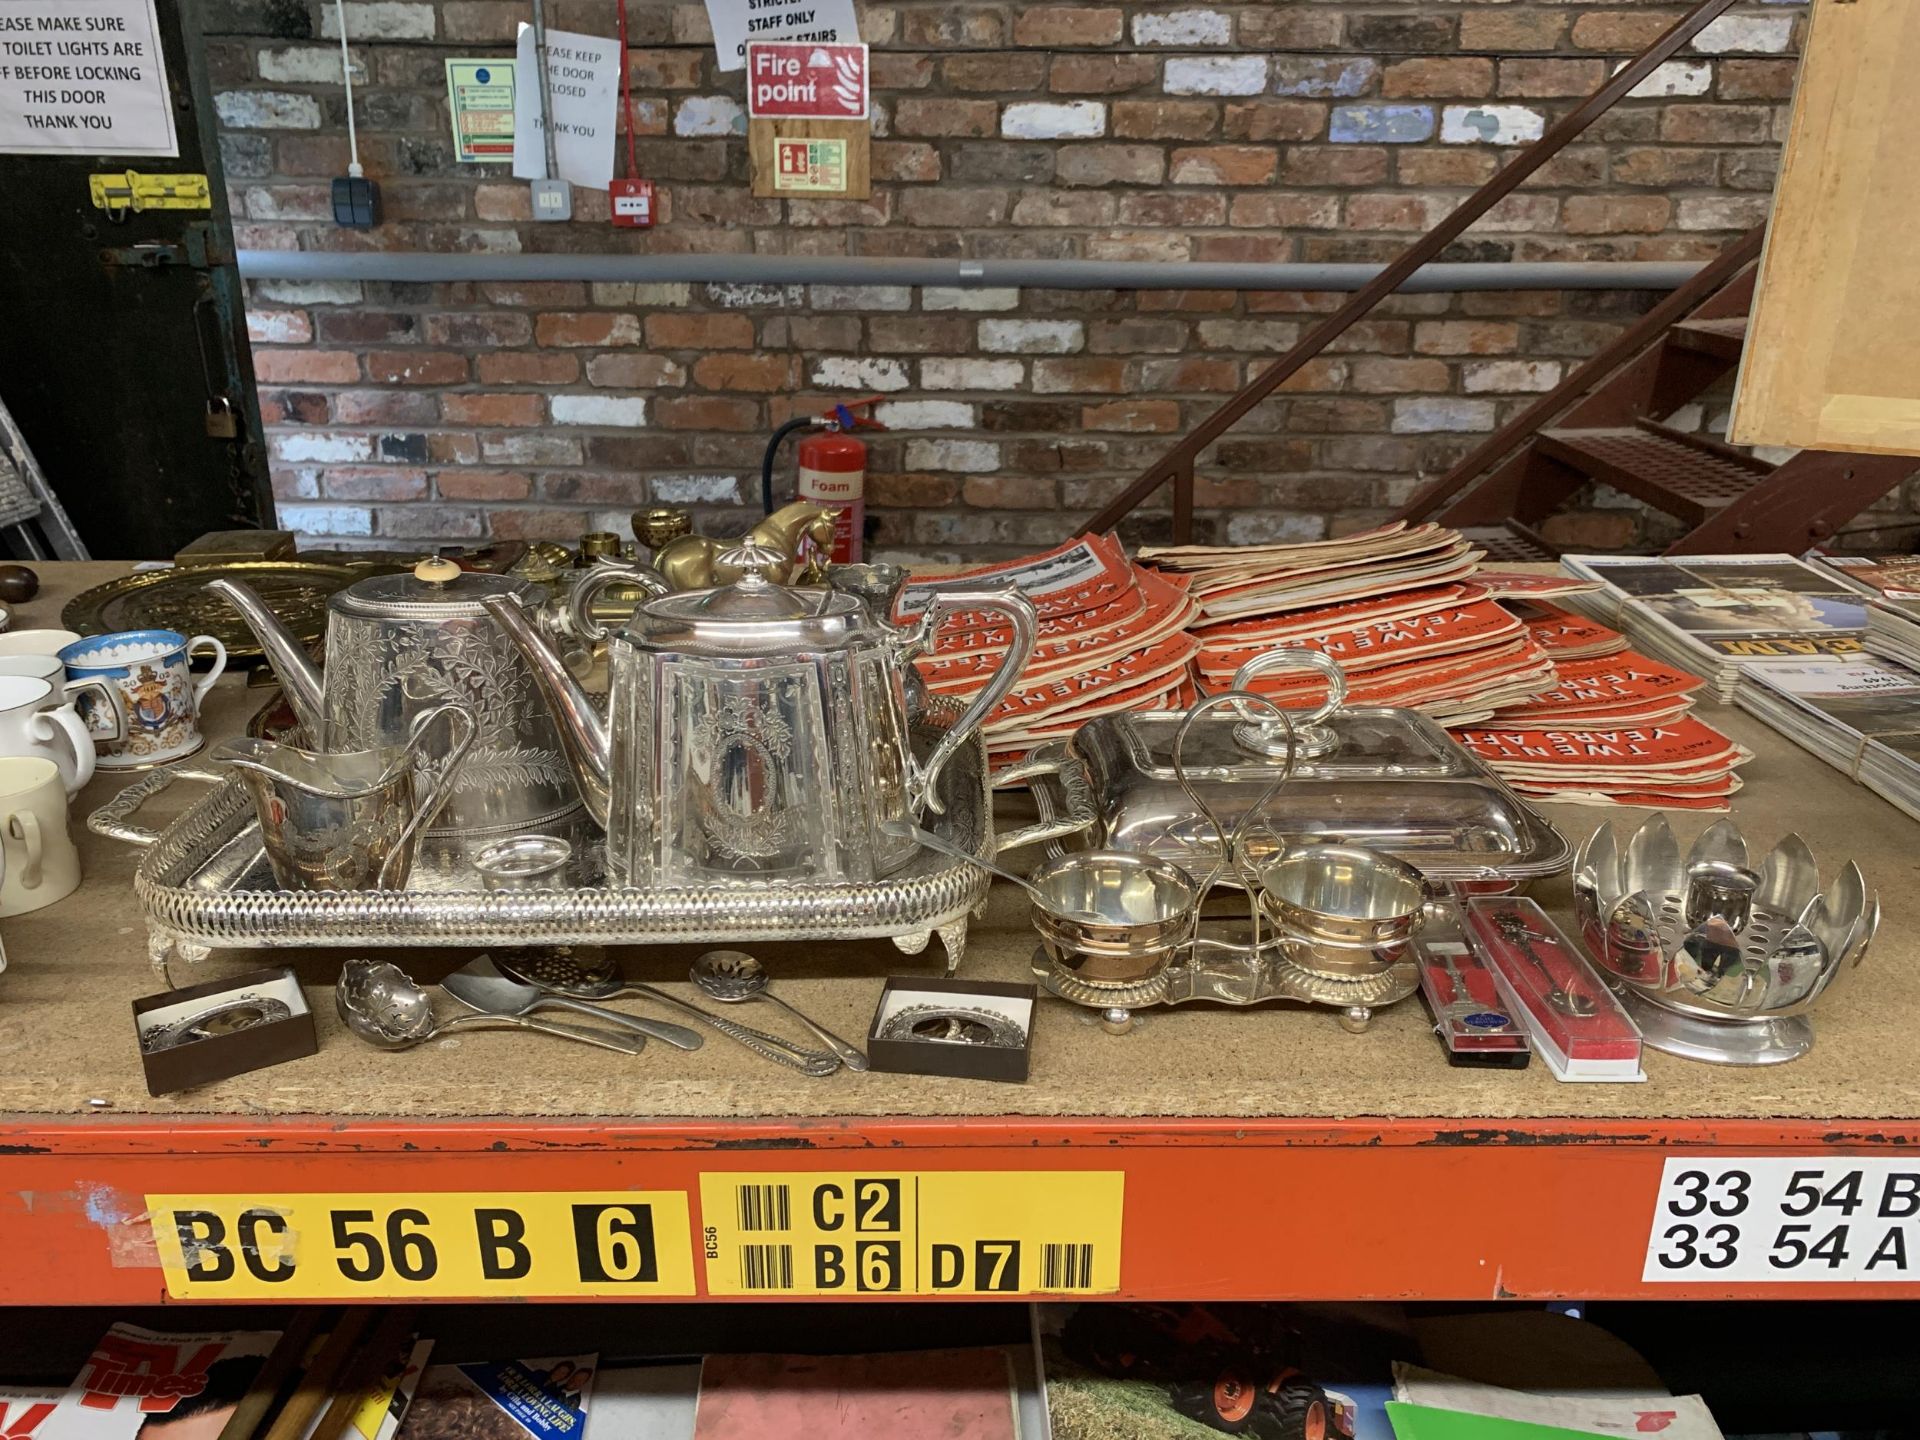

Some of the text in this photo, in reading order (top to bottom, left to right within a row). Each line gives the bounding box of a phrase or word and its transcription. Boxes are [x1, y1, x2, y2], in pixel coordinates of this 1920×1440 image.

[0, 17, 125, 31] EASE MAKE SURE
[748, 10, 815, 32] STAFF ONLY
[3, 42, 144, 57] TOILET LIGHTS ARE
[546, 45, 602, 64] EASE KEEP
[15, 66, 72, 81] BEFORE
[76, 67, 141, 81] LOCKING
[562, 66, 595, 81] DOOR
[757, 53, 801, 76] Fire
[24, 90, 106, 104] THIS DOOR
[757, 79, 817, 107] point
[24, 115, 113, 130] THANK YOU
[572, 125, 595, 138] YOU
[811, 479, 850, 492] Foam
[1713, 637, 1863, 656] EAM
[1558, 670, 1655, 690] YEAR
[1460, 728, 1681, 747] YEARS AFT
[1668, 1170, 1920, 1218] 33 54 B
[812, 1182, 891, 1232] C 2
[172, 1206, 643, 1283] BC 56 B 6
[705, 1226, 719, 1260] BC56
[1658, 1224, 1908, 1270] 33 54 A
[814, 1243, 892, 1290] B 6
[931, 1244, 1012, 1290] D 7
[84, 1356, 209, 1398] Times
[506, 1391, 522, 1406] Cilla
[520, 1404, 535, 1416] and
[531, 1413, 553, 1432] Bobby
